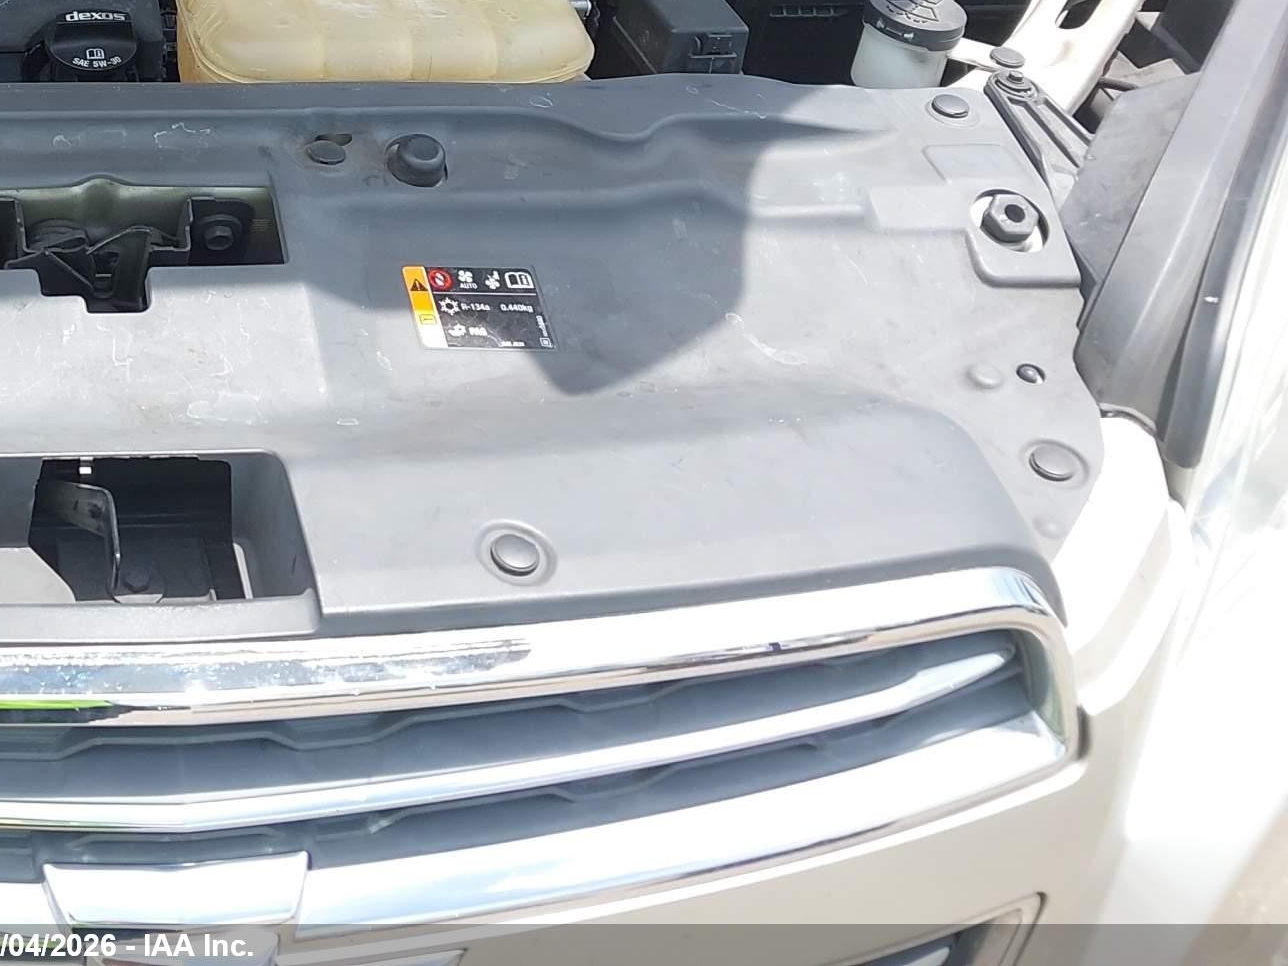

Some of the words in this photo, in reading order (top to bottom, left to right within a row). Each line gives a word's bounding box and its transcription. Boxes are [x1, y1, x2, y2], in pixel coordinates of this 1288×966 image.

[65, 11, 127, 22] dexos
[72, 57, 90, 68] SAE
[92, 56, 122, 68] 5W-30
[459, 282, 478, 290] AUTO
[460, 302, 491, 311] R-134a
